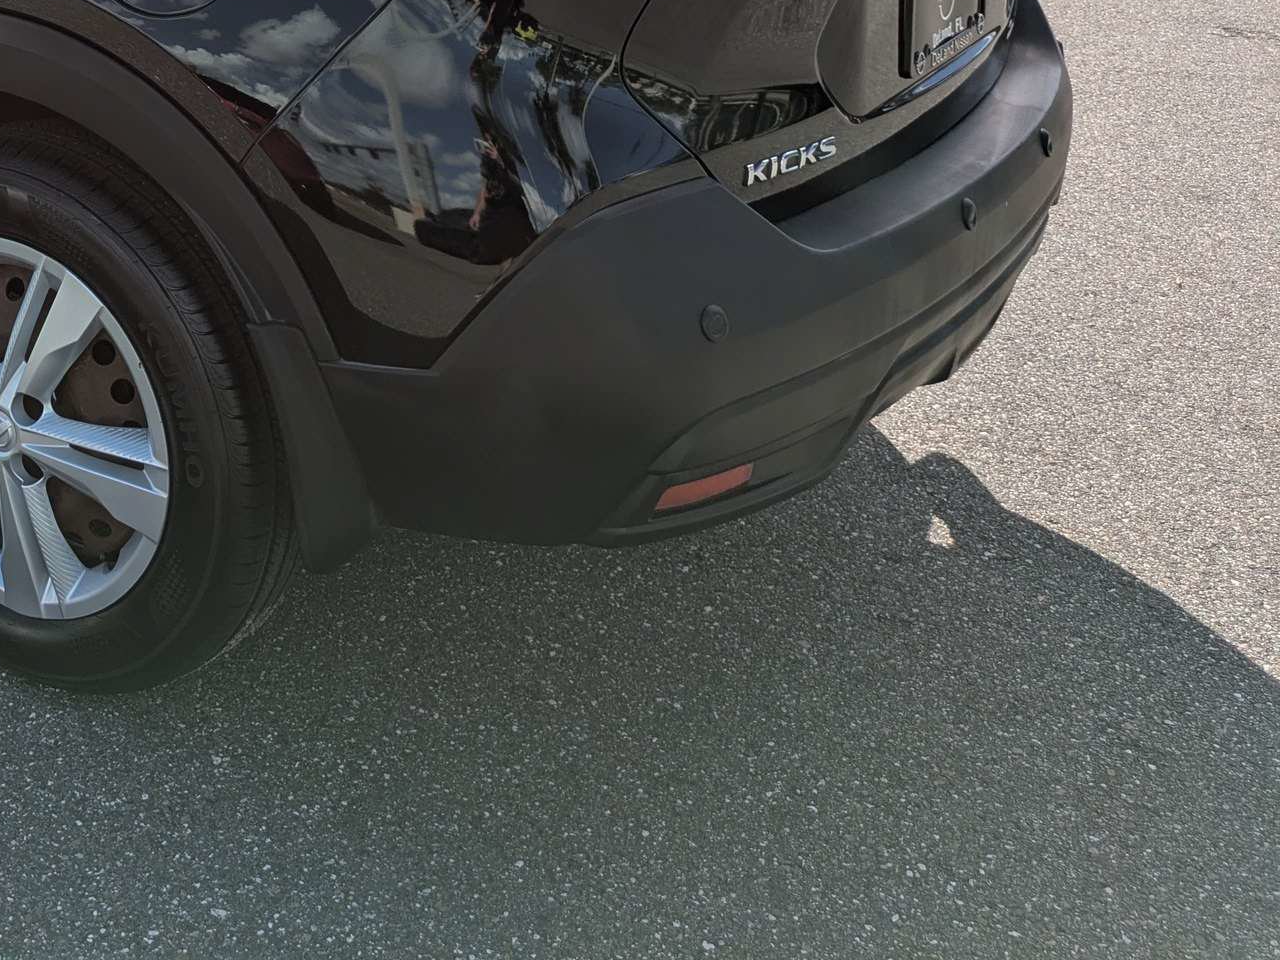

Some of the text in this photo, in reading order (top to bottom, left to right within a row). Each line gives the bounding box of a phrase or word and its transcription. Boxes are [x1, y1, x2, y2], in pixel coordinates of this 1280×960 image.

[955, 16, 964, 33] FL
[745, 135, 837, 187] KICKS
[138, 321, 205, 489] KUMHO
